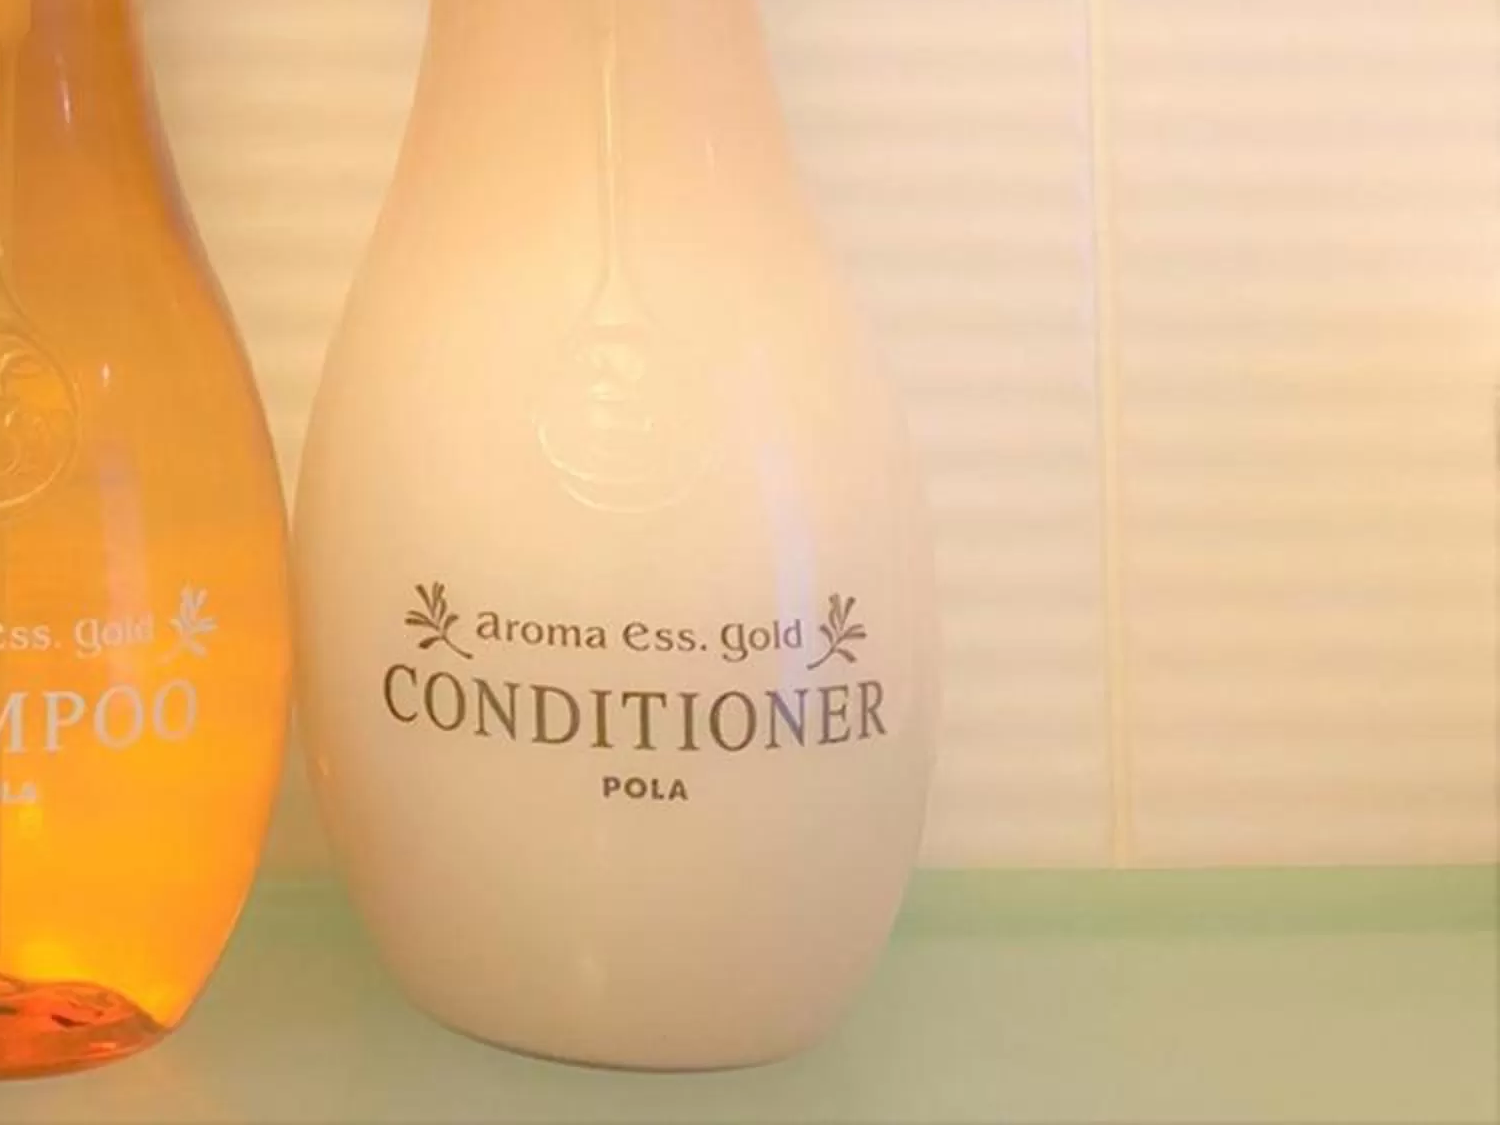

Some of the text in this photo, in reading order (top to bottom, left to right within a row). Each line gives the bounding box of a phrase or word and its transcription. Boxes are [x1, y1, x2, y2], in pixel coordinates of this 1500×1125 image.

[73, 613, 155, 659] gold
[475, 609, 803, 663] aroma ess. gold
[382, 663, 888, 752] CONDITIONER
[602, 776, 689, 801] POLA
